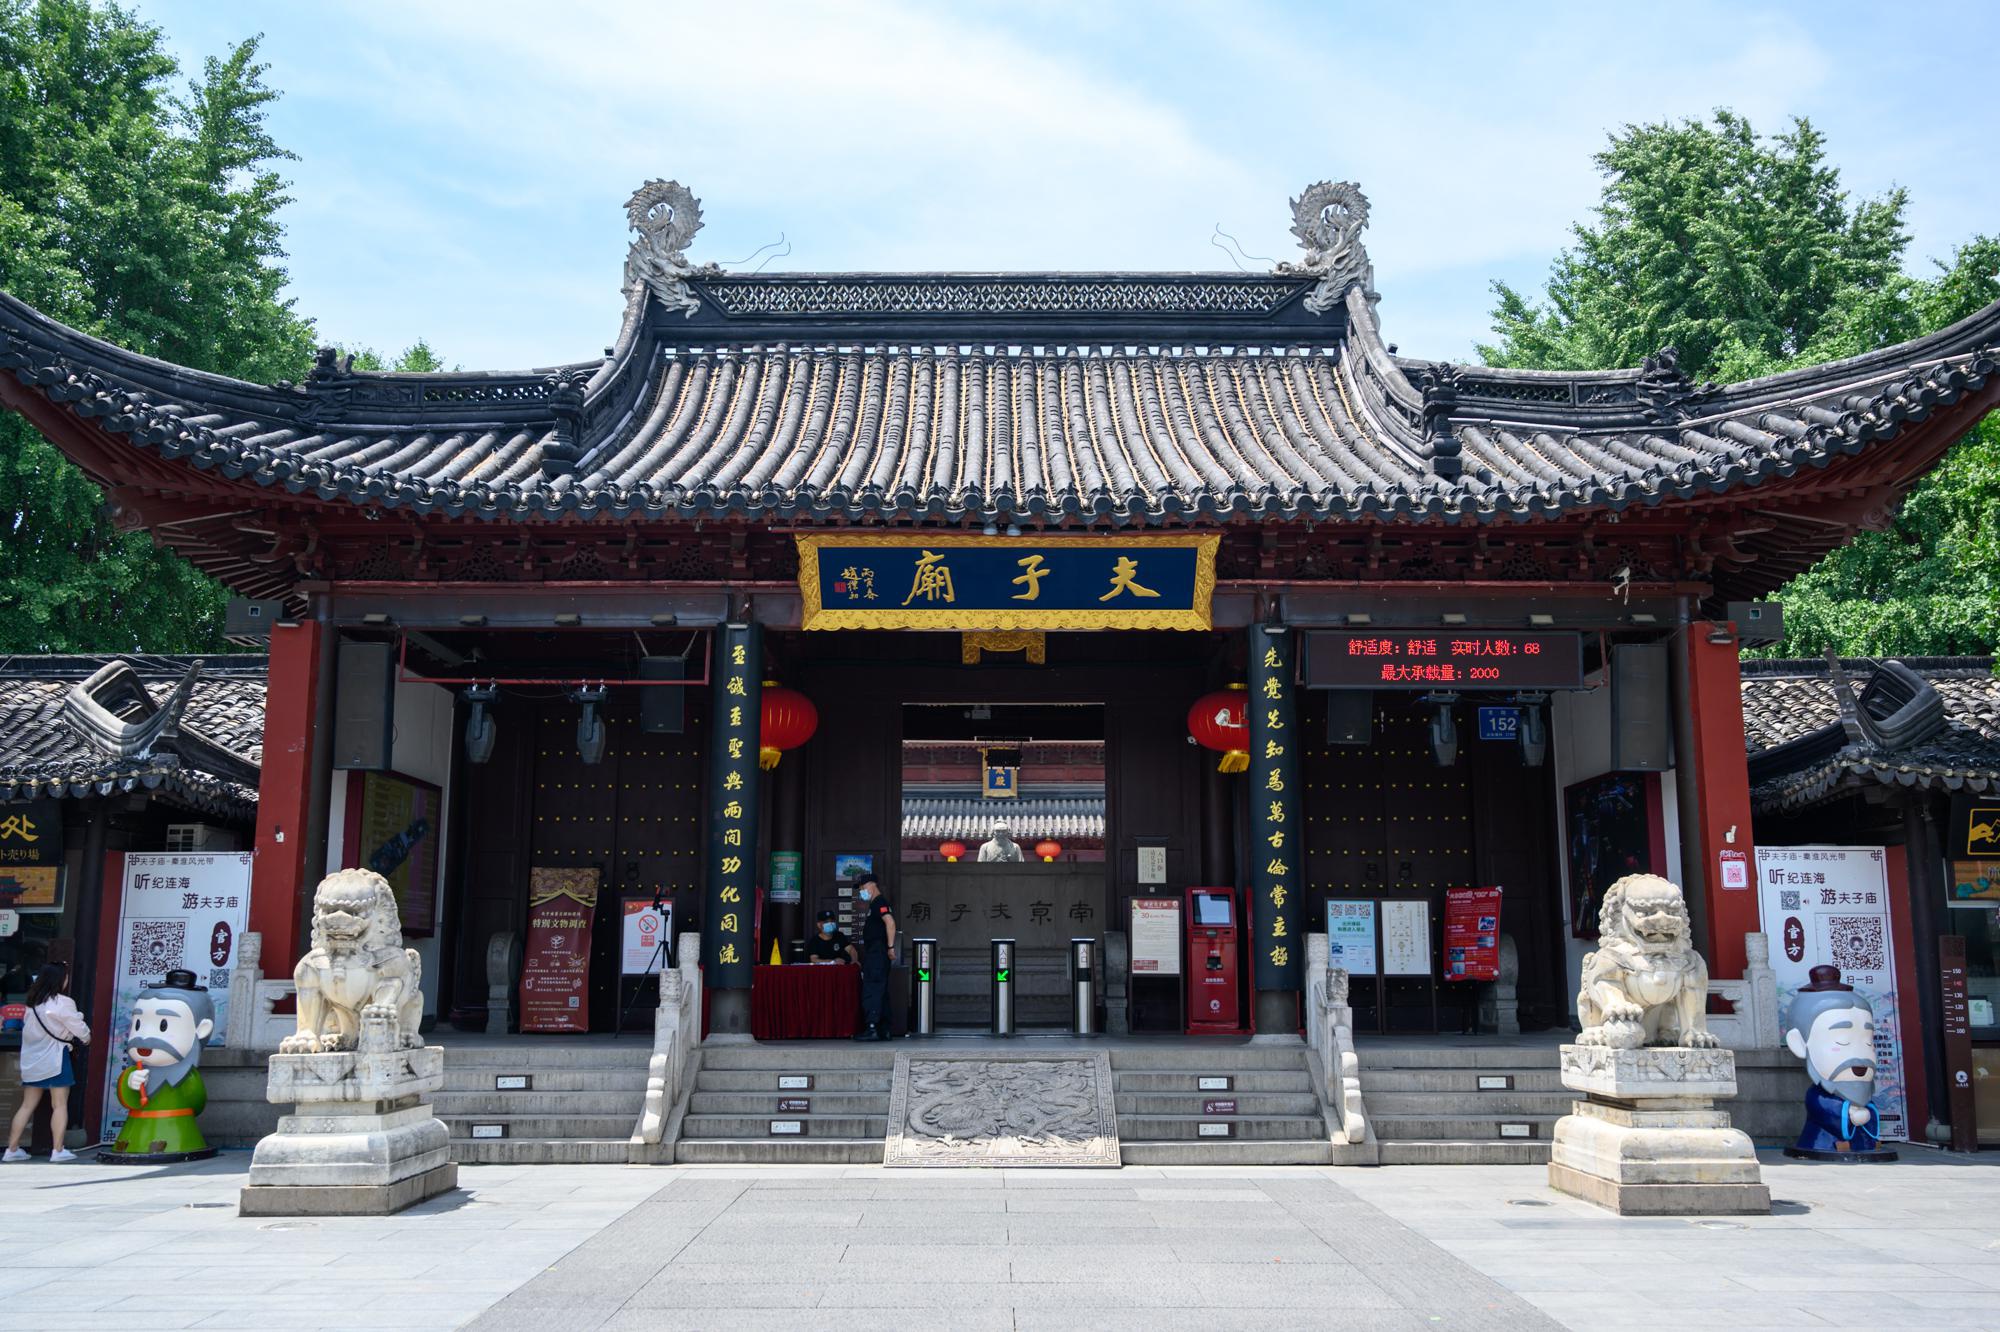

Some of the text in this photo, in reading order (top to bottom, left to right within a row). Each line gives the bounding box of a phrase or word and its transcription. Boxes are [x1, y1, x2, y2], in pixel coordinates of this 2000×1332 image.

[1490, 717, 1516, 731] 152
[0, 814, 39, 842] 处
[134, 873, 191, 890] 听纪连海
[1769, 868, 1826, 885] 听纪连海
[182, 892, 239, 909] 游夫子庙
[1820, 888, 1877, 905] 游夫子庙
[213, 929, 228, 961] 官方
[1788, 925, 1801, 956] 官方
[1000, 949, 1008, 965] 入口
[1079, 948, 1088, 964] 入口
[1846, 975, 1874, 985] 扫一扫
